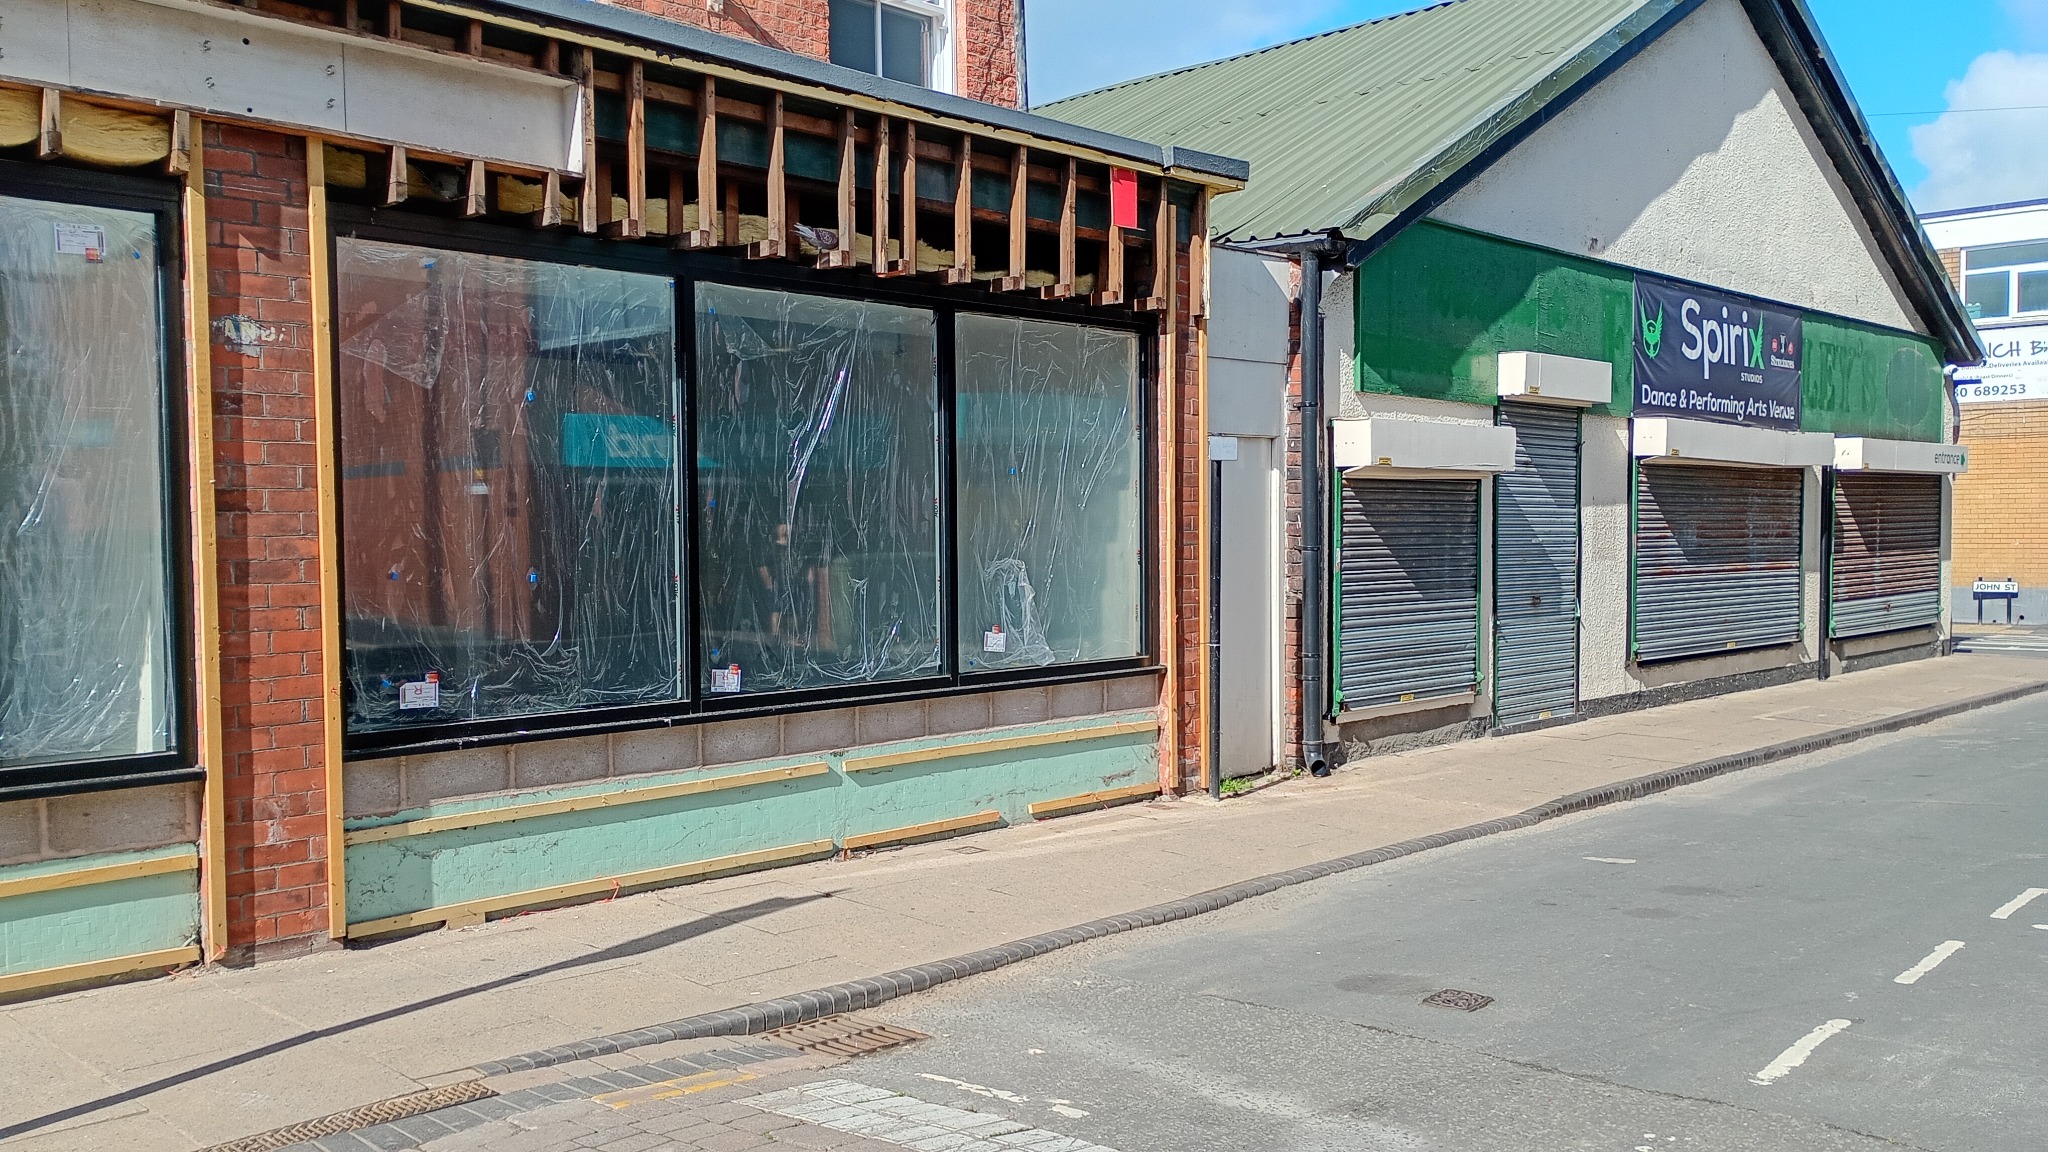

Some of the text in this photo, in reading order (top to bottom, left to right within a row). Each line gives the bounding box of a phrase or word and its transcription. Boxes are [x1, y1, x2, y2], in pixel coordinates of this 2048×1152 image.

[1681, 298, 1765, 380] Spirix
[1740, 371, 1763, 384] STUDIOS
[1974, 383, 2026, 396] 689253
[1641, 384, 1795, 421] Dance & Performing Arts Venue
[1934, 451, 1960, 465] entrance
[1975, 583, 2016, 591] JOHN ST
